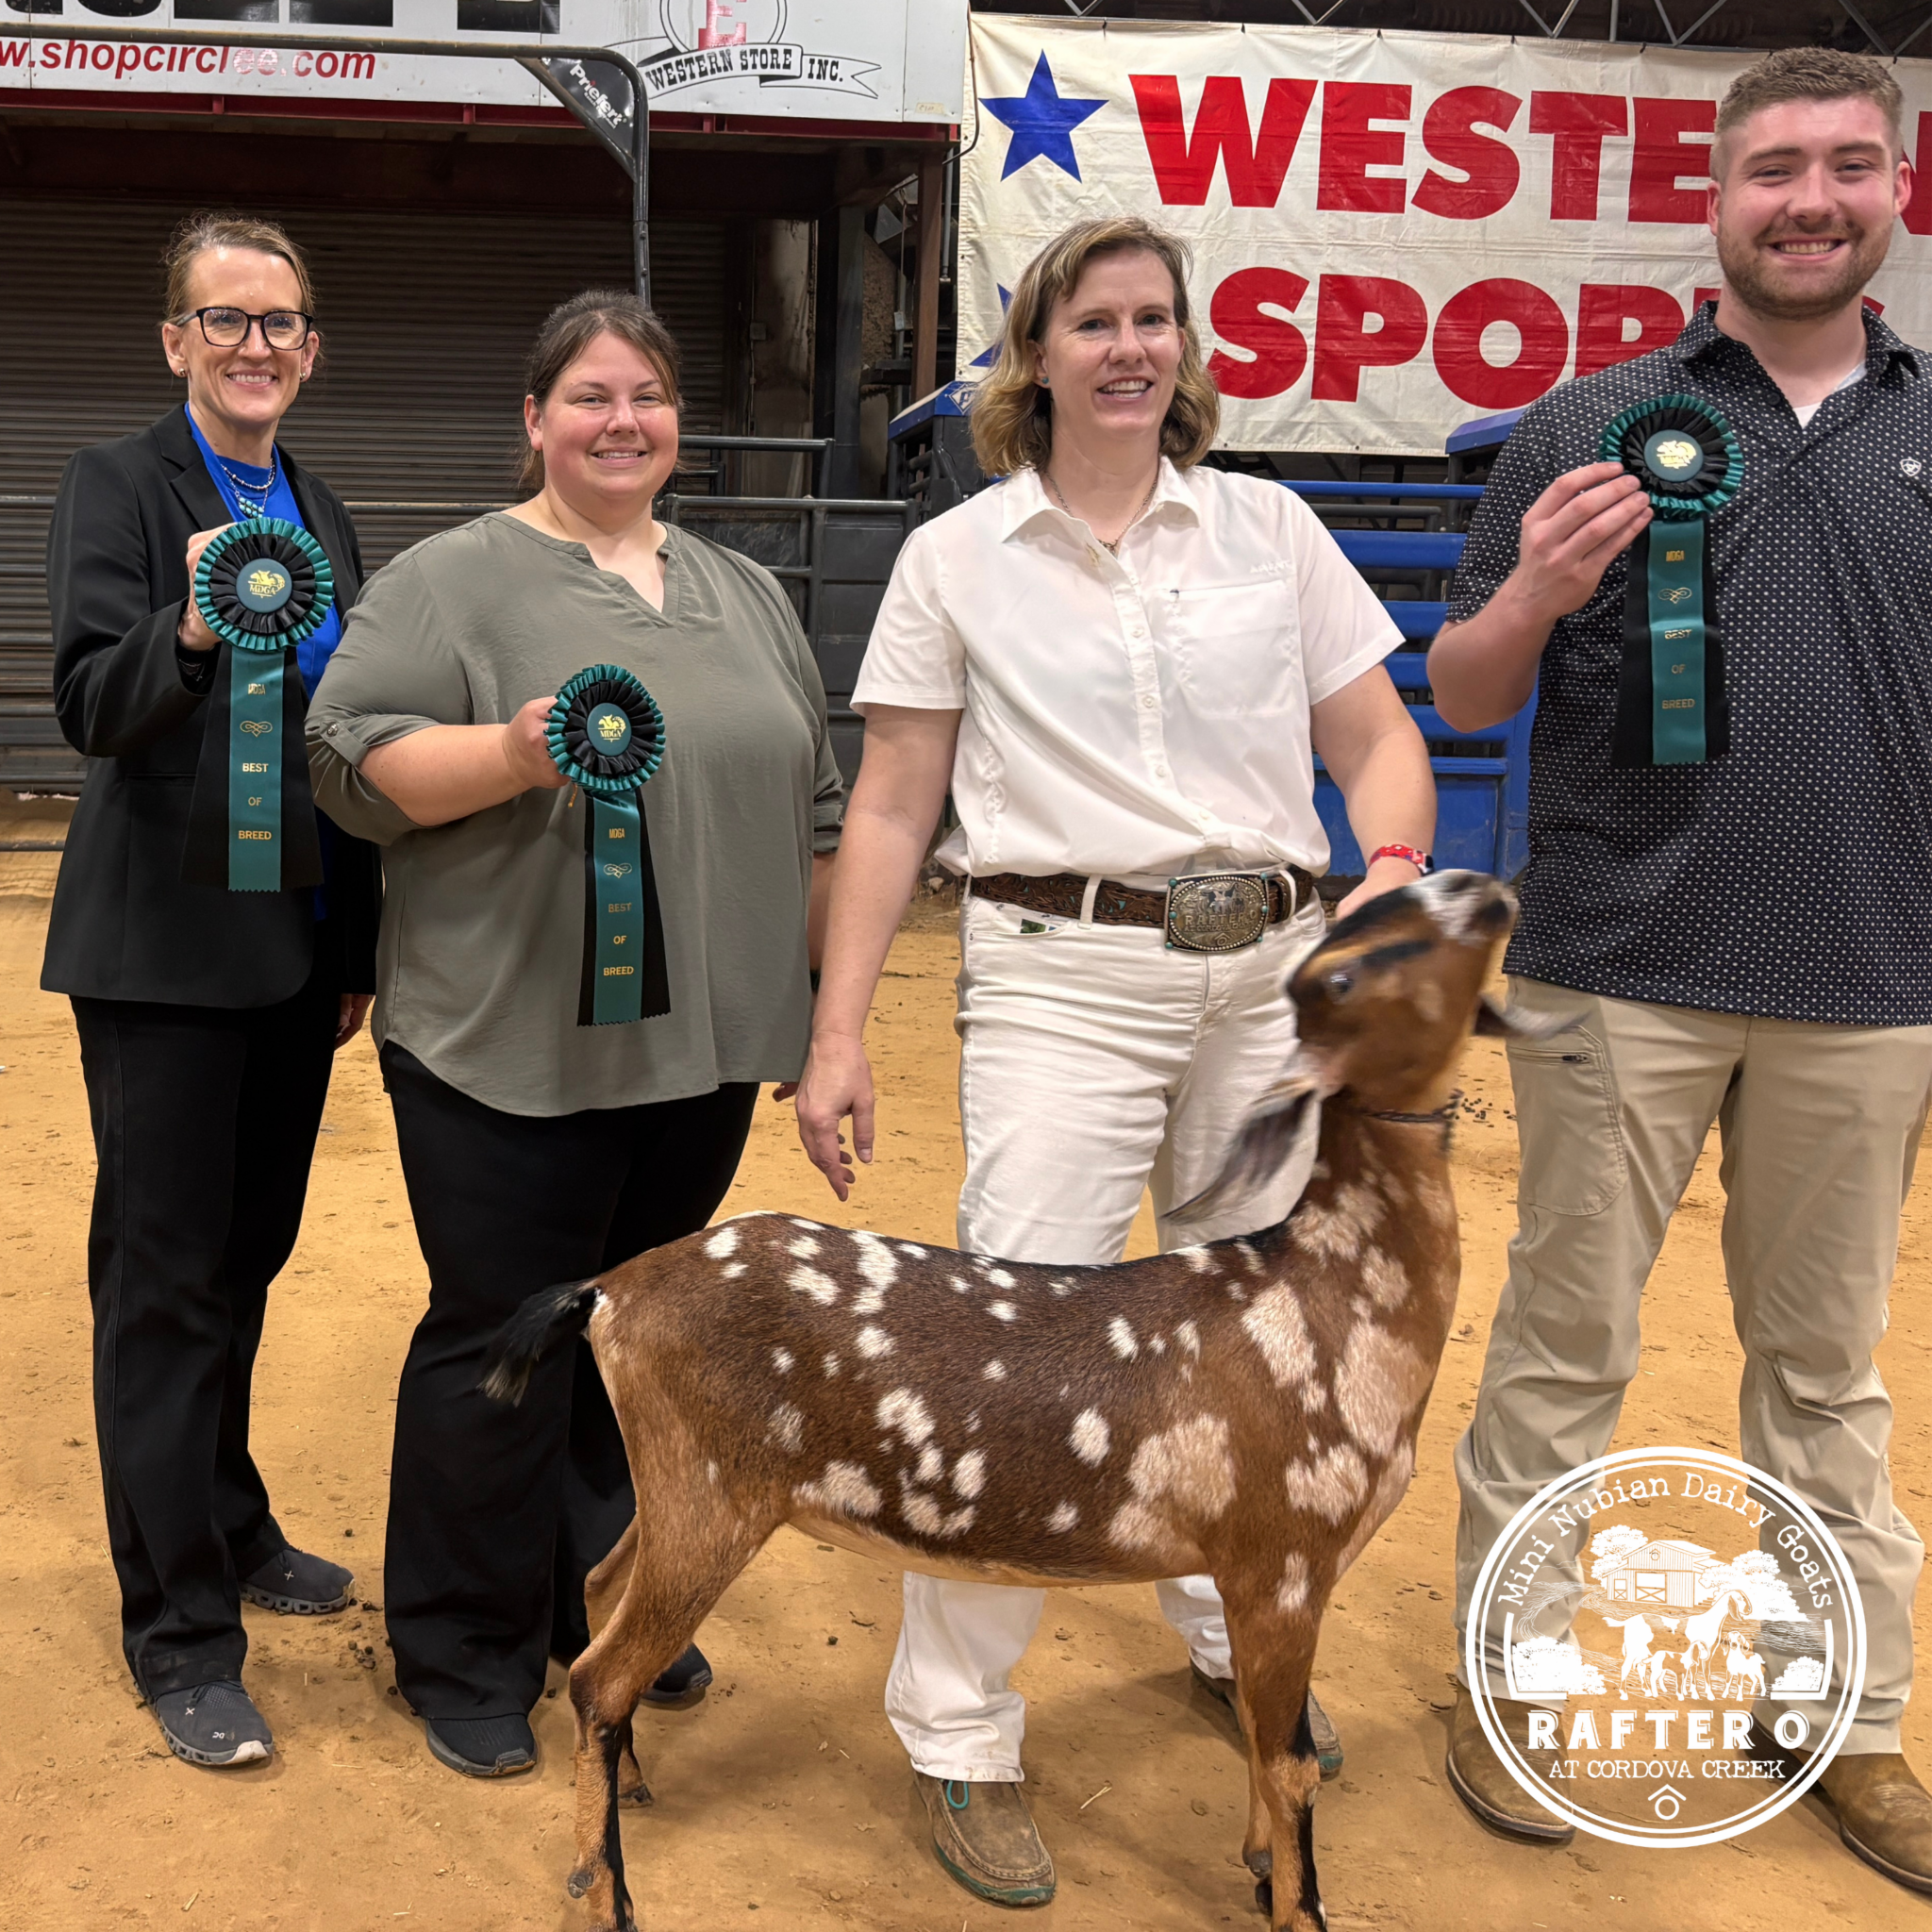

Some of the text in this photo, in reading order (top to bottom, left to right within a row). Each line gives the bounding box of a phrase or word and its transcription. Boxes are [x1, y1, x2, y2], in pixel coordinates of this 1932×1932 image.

[645, 48, 843, 91] WESTERN STORE INC.
[569, 63, 623, 125] Priefert
[1128, 74, 1932, 236] WESTE
[249, 583, 276, 595] MDGA
[1664, 628, 1692, 640] BEST
[1671, 663, 1686, 675] OF
[1661, 698, 1696, 709] BREED
[242, 761, 269, 773] BEST
[247, 796, 263, 807] OF
[238, 829, 273, 841] BREED
[608, 902, 633, 913] BEST
[613, 934, 627, 945] OF
[603, 965, 634, 976] BREED
